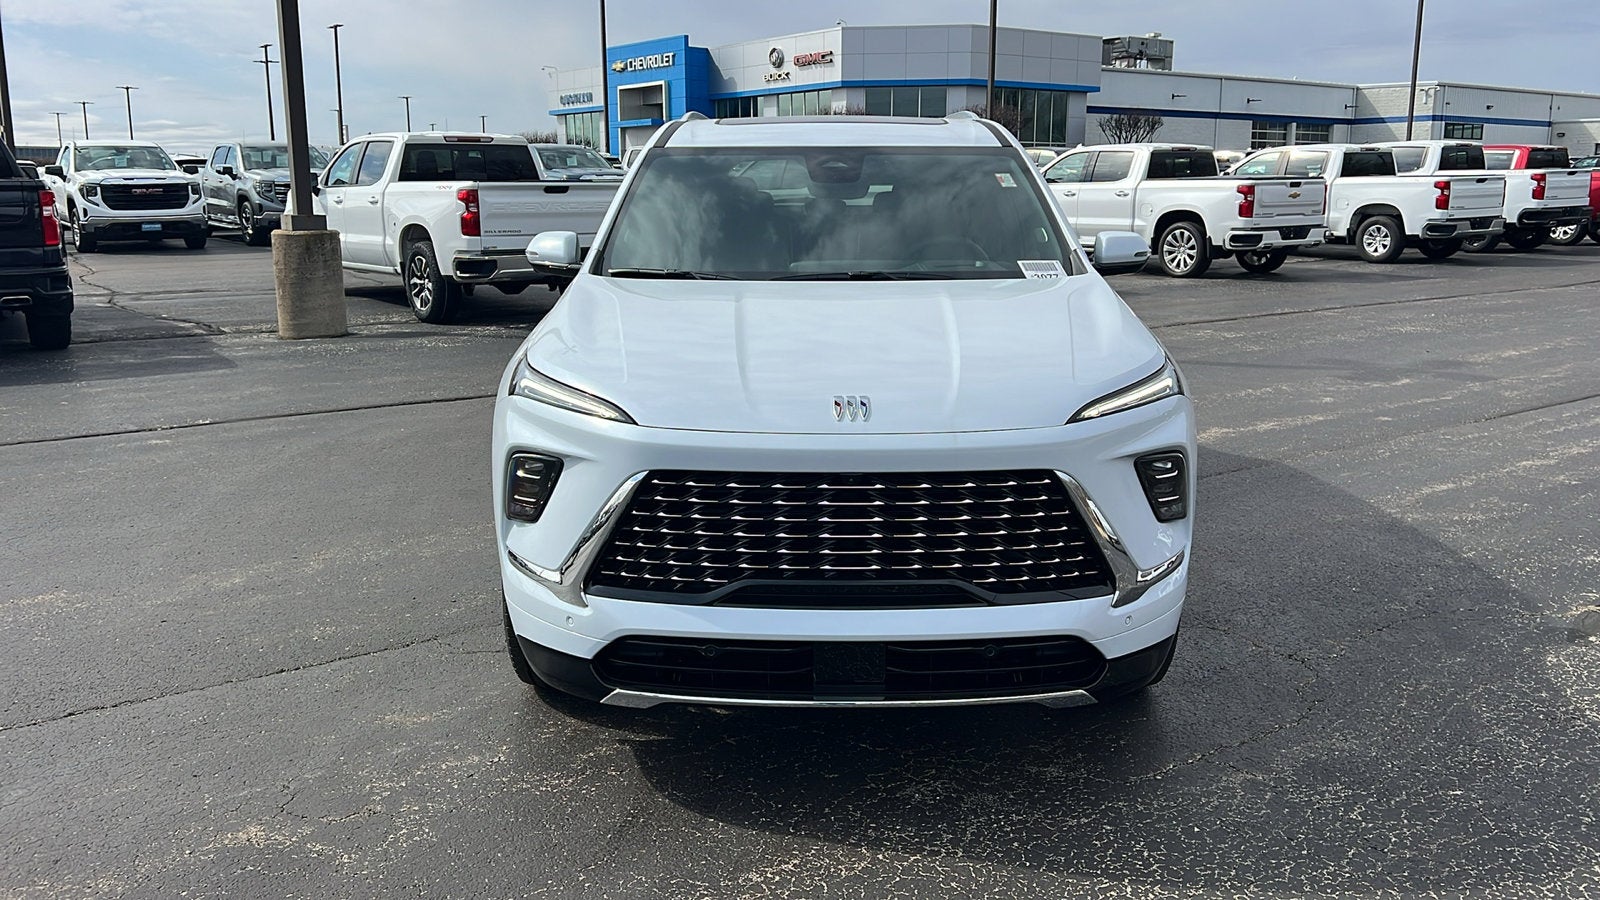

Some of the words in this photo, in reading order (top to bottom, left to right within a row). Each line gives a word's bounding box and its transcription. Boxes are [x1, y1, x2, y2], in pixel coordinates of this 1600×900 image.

[627, 52, 674, 71] CHEVROLET
[794, 51, 833, 67] GMC
[763, 71, 790, 82] BUICK
[490, 201, 609, 213] CHEVROLE
